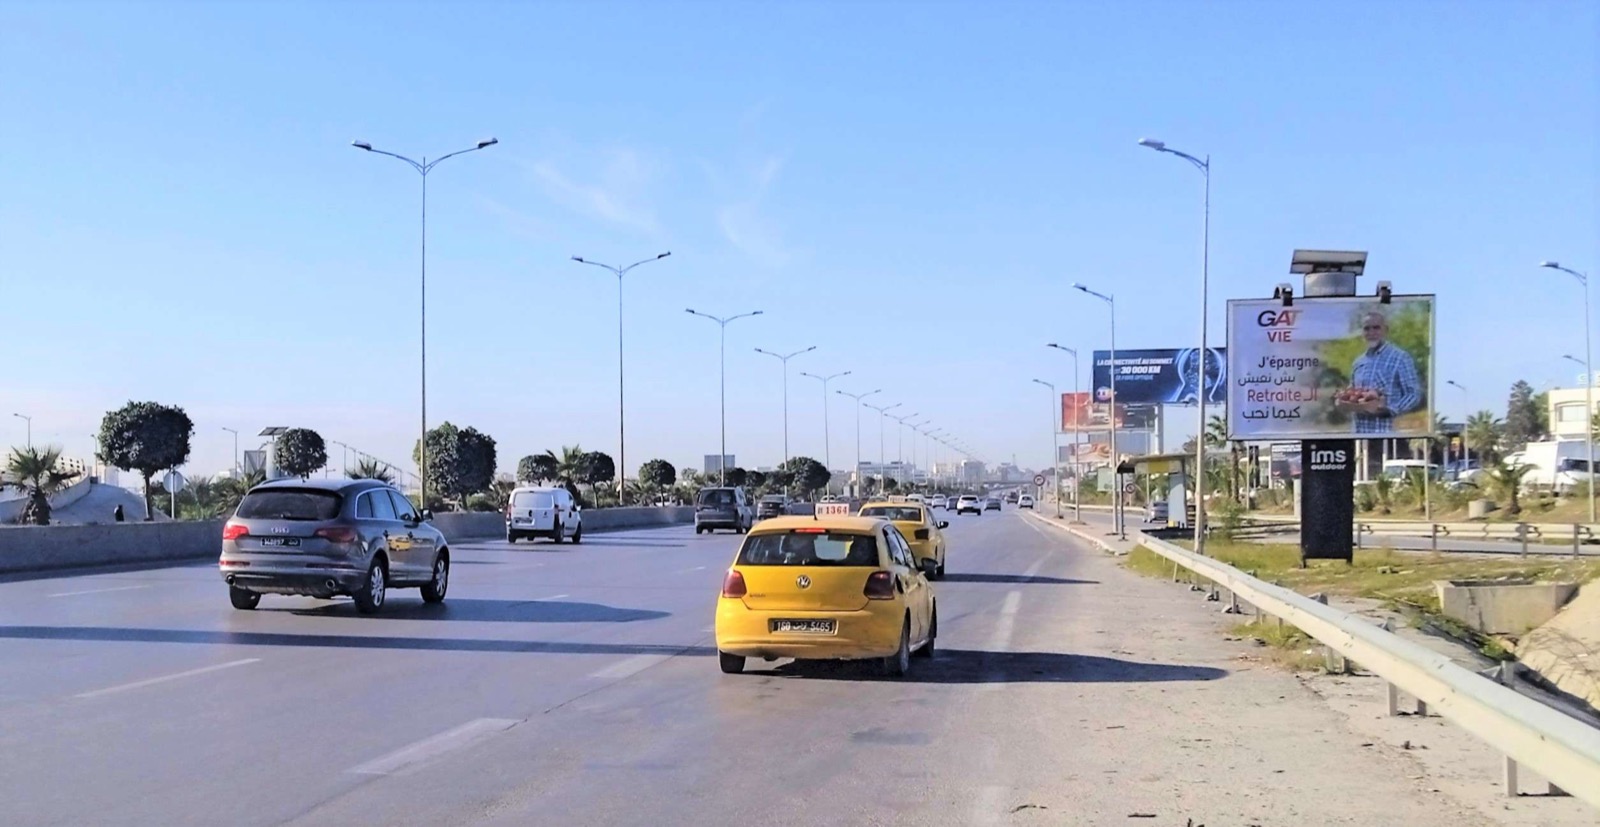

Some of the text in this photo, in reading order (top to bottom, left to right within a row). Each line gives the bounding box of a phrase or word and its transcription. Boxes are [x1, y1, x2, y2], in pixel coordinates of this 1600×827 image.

[1257, 310, 1303, 327] GAT
[1267, 331, 1292, 342] VIE
[1121, 366, 1131, 374] 30
[1132, 366, 1148, 374] 000
[1148, 365, 1161, 374] KM
[1258, 355, 1319, 371] J'épargne
[1238, 371, 1295, 387] بش نعيش
[1247, 388, 1302, 402] Retraite
[1242, 406, 1301, 423] كيما نحب
[1311, 444, 1346, 463] ims
[826, 506, 848, 515] 1364
